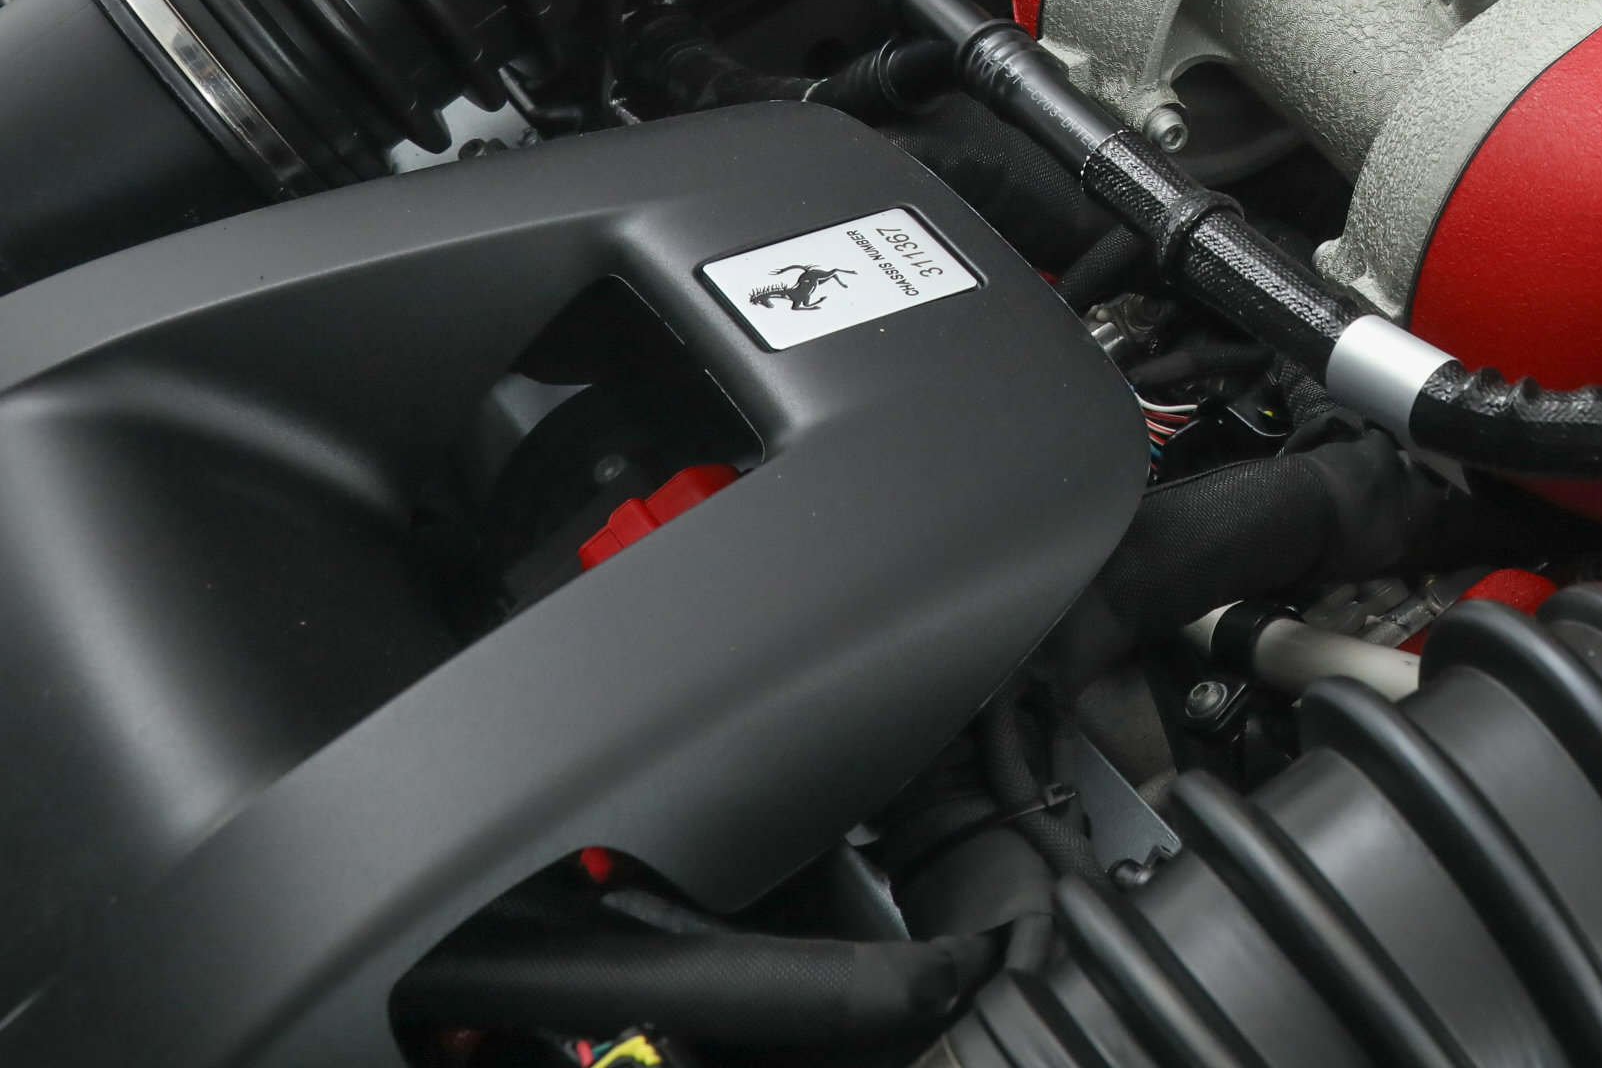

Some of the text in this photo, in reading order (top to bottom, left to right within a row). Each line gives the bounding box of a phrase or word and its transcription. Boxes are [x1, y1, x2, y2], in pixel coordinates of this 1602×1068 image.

[846, 229, 920, 297] CHASSIS NUMBER
[875, 227, 944, 278] 311367
